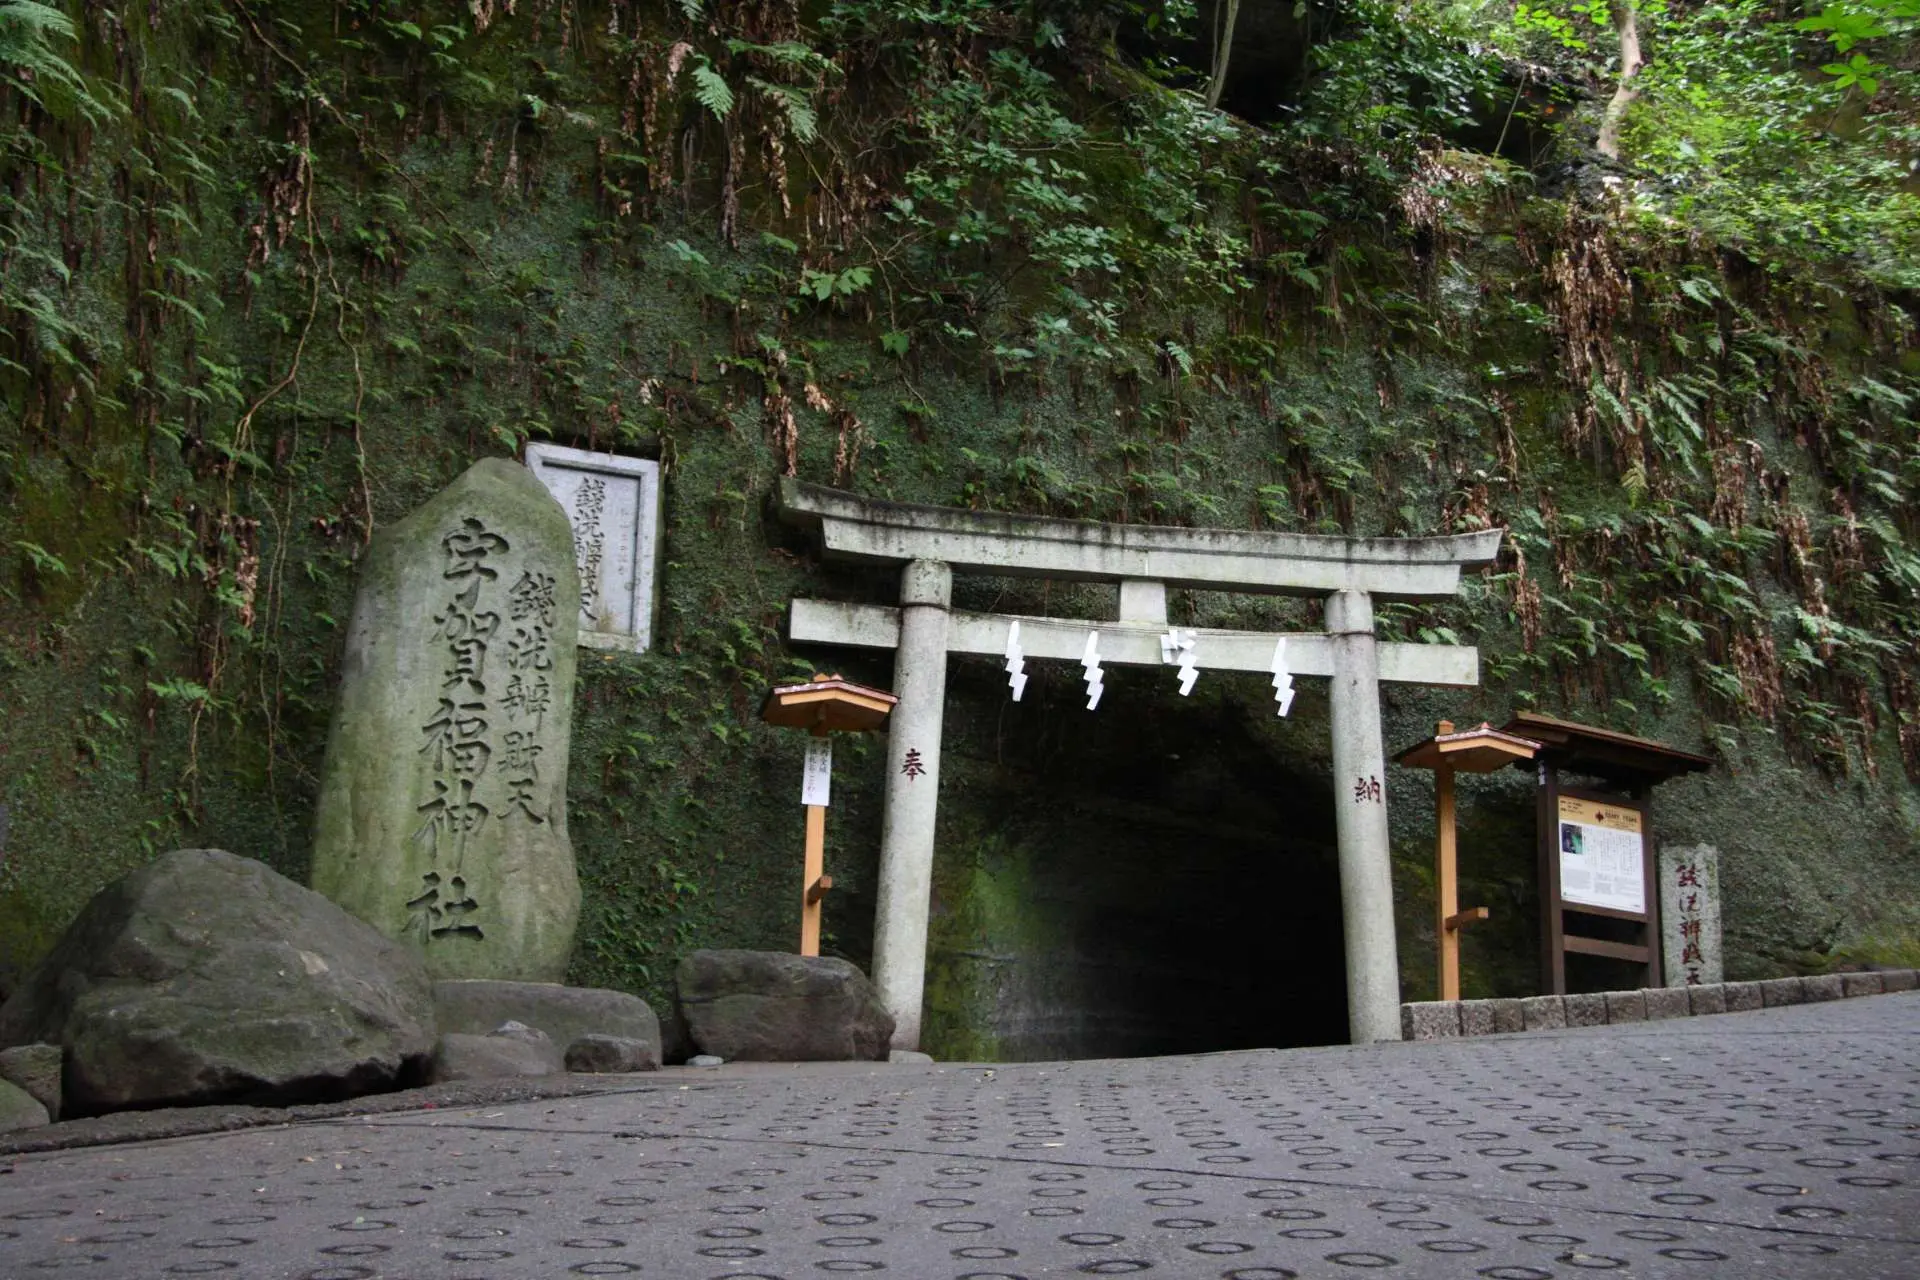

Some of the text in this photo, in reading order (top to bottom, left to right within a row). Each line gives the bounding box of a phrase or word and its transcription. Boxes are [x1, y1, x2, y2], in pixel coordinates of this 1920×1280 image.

[401, 517, 510, 945] 宇賀福神社
[900, 748, 927, 781] 奉
[1354, 775, 1380, 804] 納
